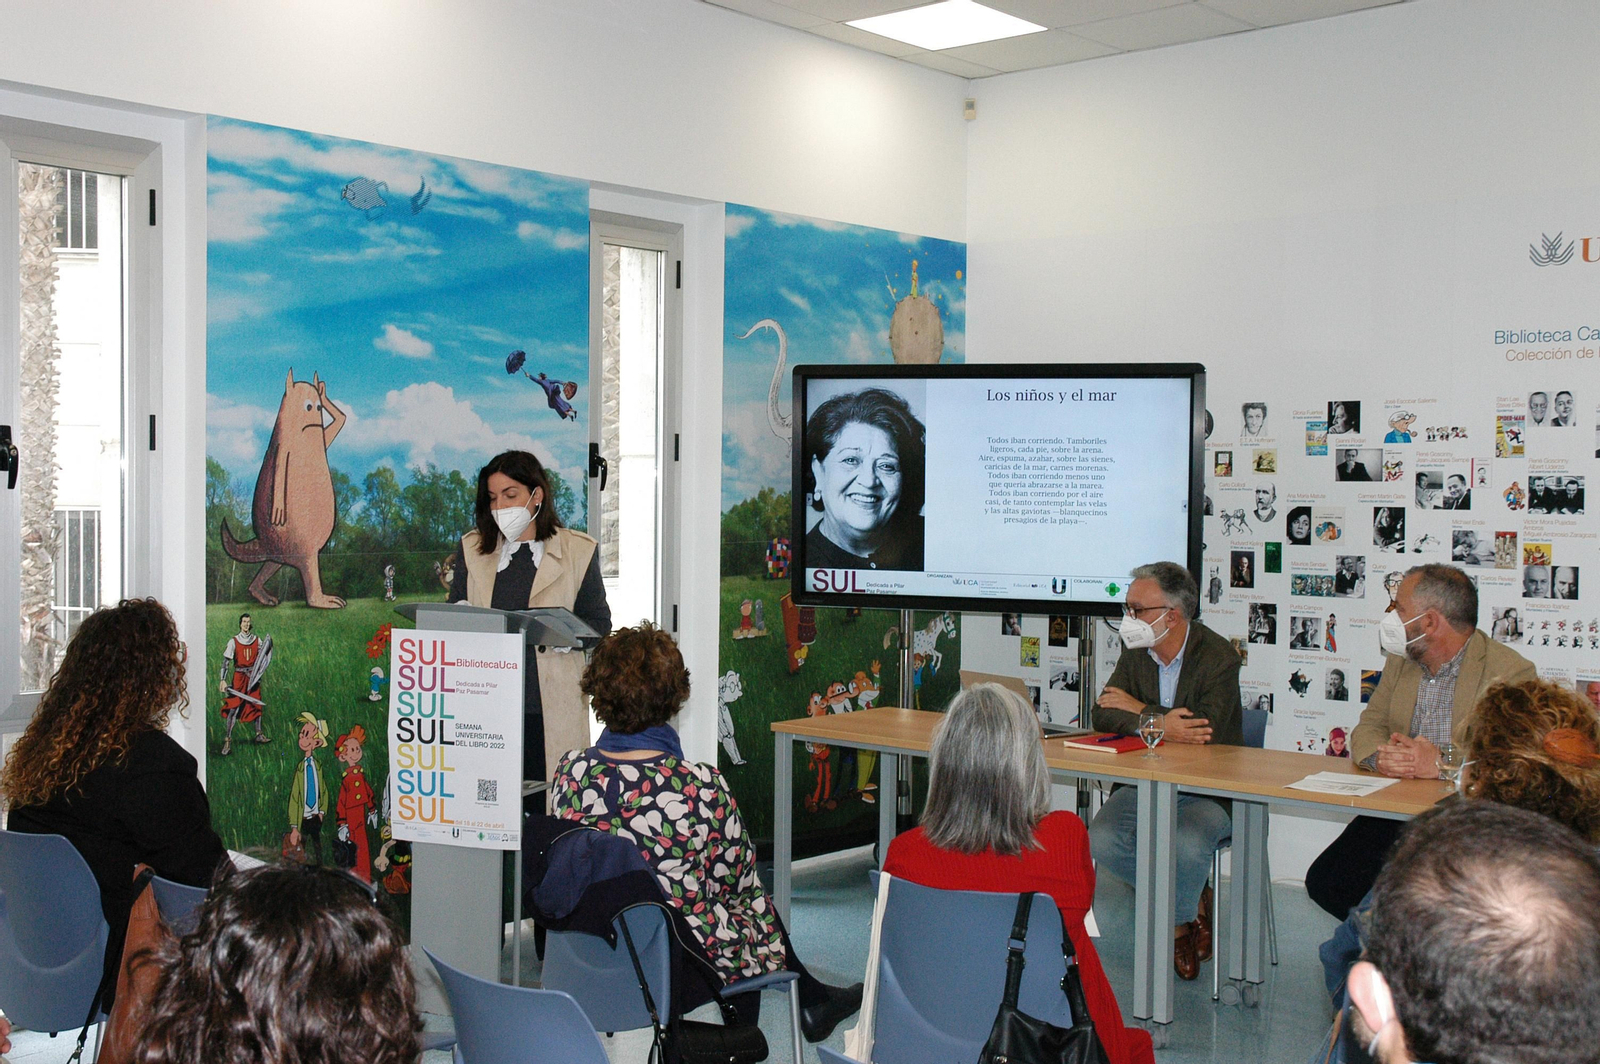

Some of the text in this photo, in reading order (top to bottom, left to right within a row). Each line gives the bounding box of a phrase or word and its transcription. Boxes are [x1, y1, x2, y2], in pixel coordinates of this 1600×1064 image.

[1494, 329, 1572, 344] Biblioteca
[1505, 346, 1594, 362] Colección de
[986, 388, 1117, 404] Los niños y el mar
[986, 436, 1108, 445] Todos iban corriendo. Tamboriles
[989, 445, 1016, 454] ligeros,
[1036, 446, 1049, 454] pie,
[978, 454, 996, 462] Aire,
[996, 455, 1027, 463] espuma,
[1028, 455, 1055, 463] azahar,
[1056, 455, 1077, 463] sobre
[1078, 455, 1089, 463] las
[1023, 463, 1030, 471] la
[987, 471, 1010, 479] Todos
[1011, 471, 1027, 479] iban
[1028, 472, 1064, 480] corriendo
[988, 481, 1002, 489] que
[1003, 480, 1026, 489] quería
[1027, 481, 1063, 489] abrazarse
[1071, 481, 1078, 489] la
[988, 489, 1011, 497] Todos
[1012, 489, 1028, 497] iban
[1029, 490, 1065, 498] corriendo
[984, 498, 1001, 506] casi,
[1002, 498, 1012, 506] de
[1033, 499, 1075, 508] contemplar
[1021, 508, 1051, 516] gaviotas
[1003, 516, 1038, 525] presagios
[1039, 516, 1049, 524] de
[812, 568, 866, 593] SUL
[398, 638, 518, 670] SUL BibliotecaUca
[397, 665, 456, 693] SUL
[456, 680, 480, 688] Dedicada
[396, 691, 455, 719] SUL
[455, 722, 482, 730] SEMANA
[396, 717, 455, 746] SUL
[455, 731, 504, 740] UNIVERSITARIA
[468, 740, 489, 748] LIBRO
[490, 741, 505, 749] 2022
[396, 743, 455, 772] SUL
[397, 769, 455, 798] SUL
[398, 795, 455, 824] SUL
[492, 821, 504, 829] abril
